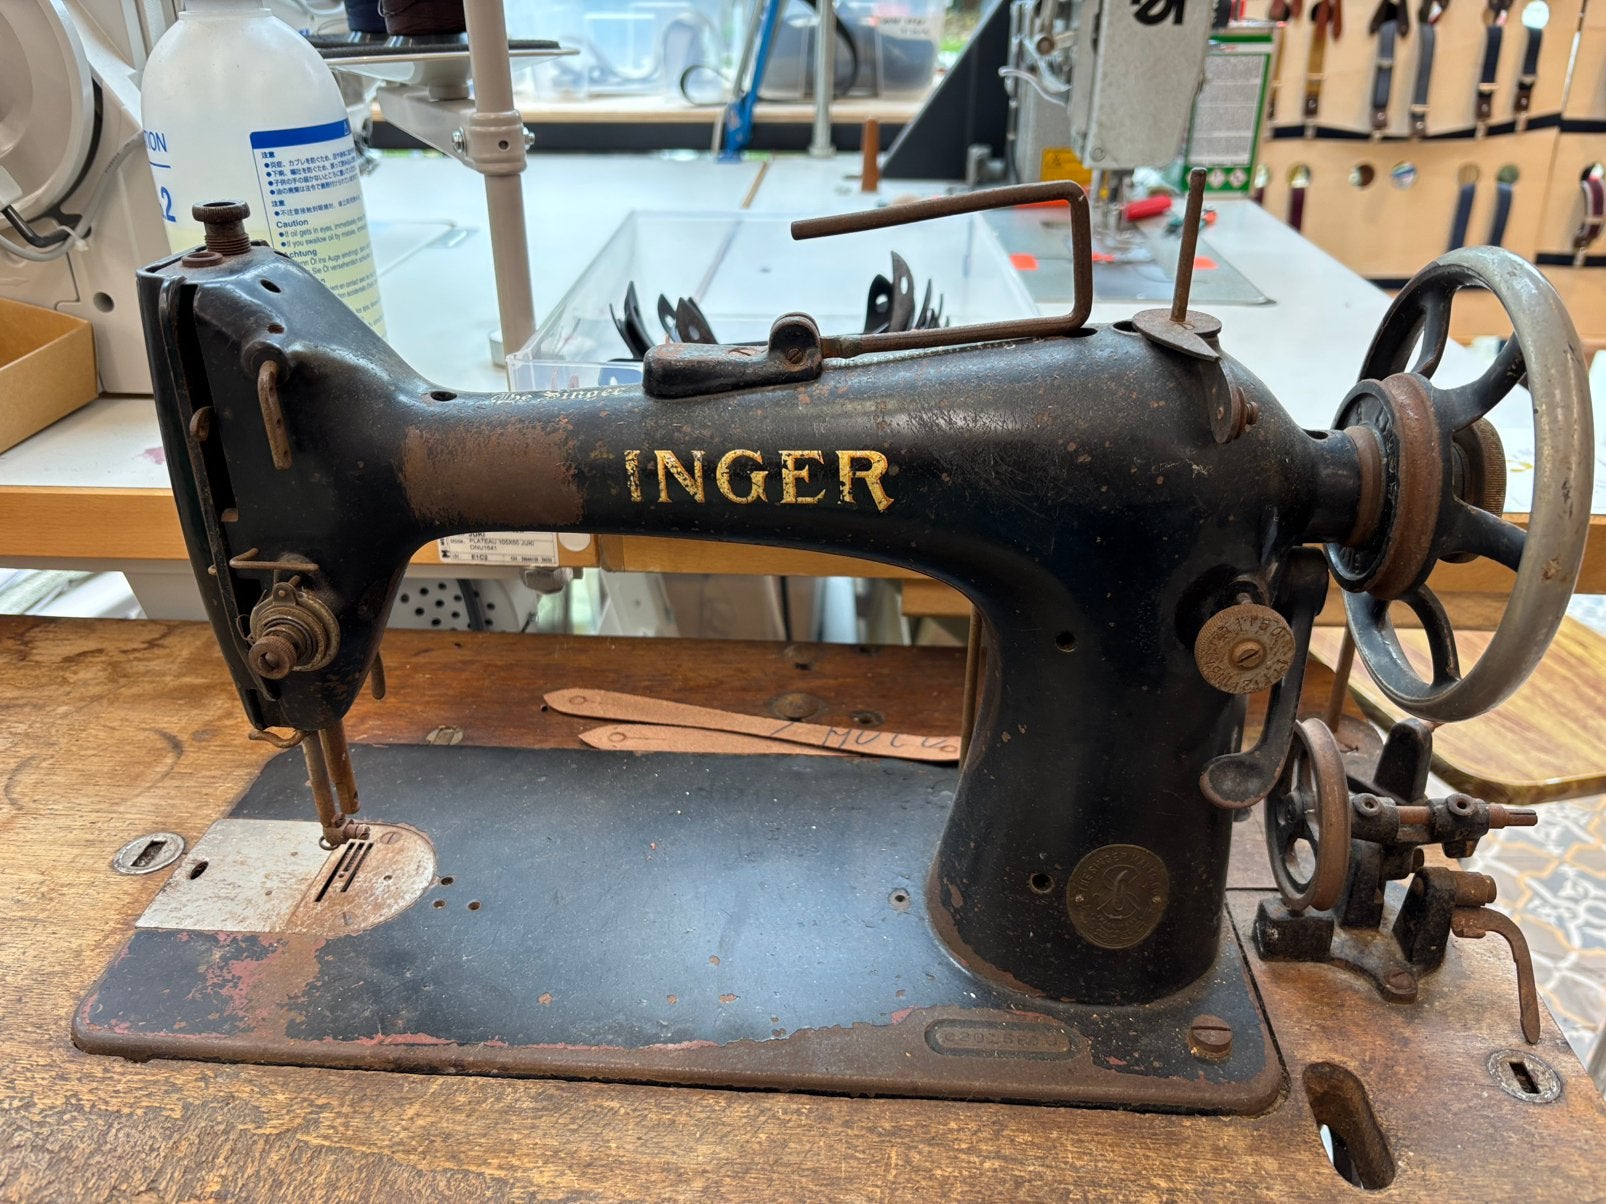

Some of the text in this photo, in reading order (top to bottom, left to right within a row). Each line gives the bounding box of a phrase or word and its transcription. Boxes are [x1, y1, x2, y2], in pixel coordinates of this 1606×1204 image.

[276, 219, 310, 229] Caution
[299, 228, 313, 238] gets
[292, 240, 304, 249] you
[305, 236, 327, 246] swallow
[328, 253, 341, 262] Auge
